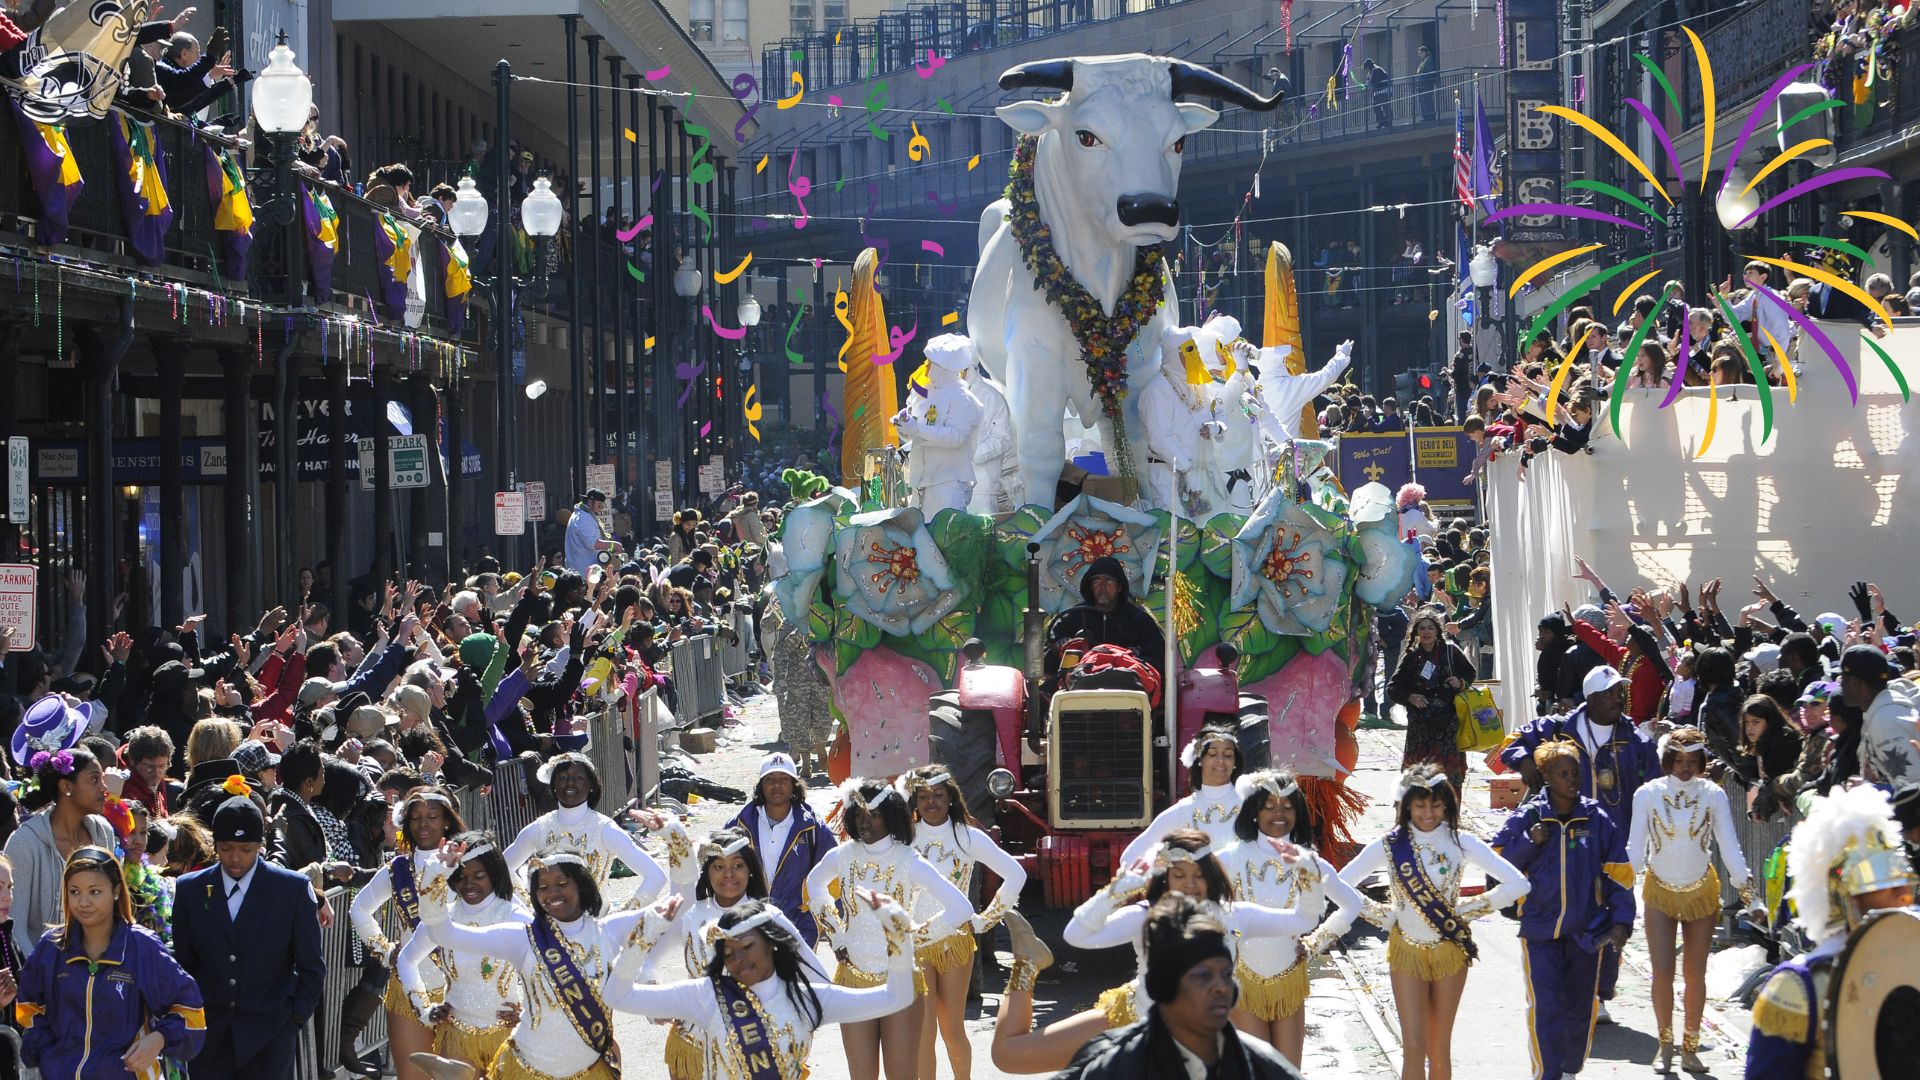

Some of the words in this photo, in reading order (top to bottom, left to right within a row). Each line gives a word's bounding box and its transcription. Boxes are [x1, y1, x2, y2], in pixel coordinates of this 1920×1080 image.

[397, 438, 422, 448] PARK
[1352, 450, 1370, 459] Who
[16, 484, 22, 494] TO
